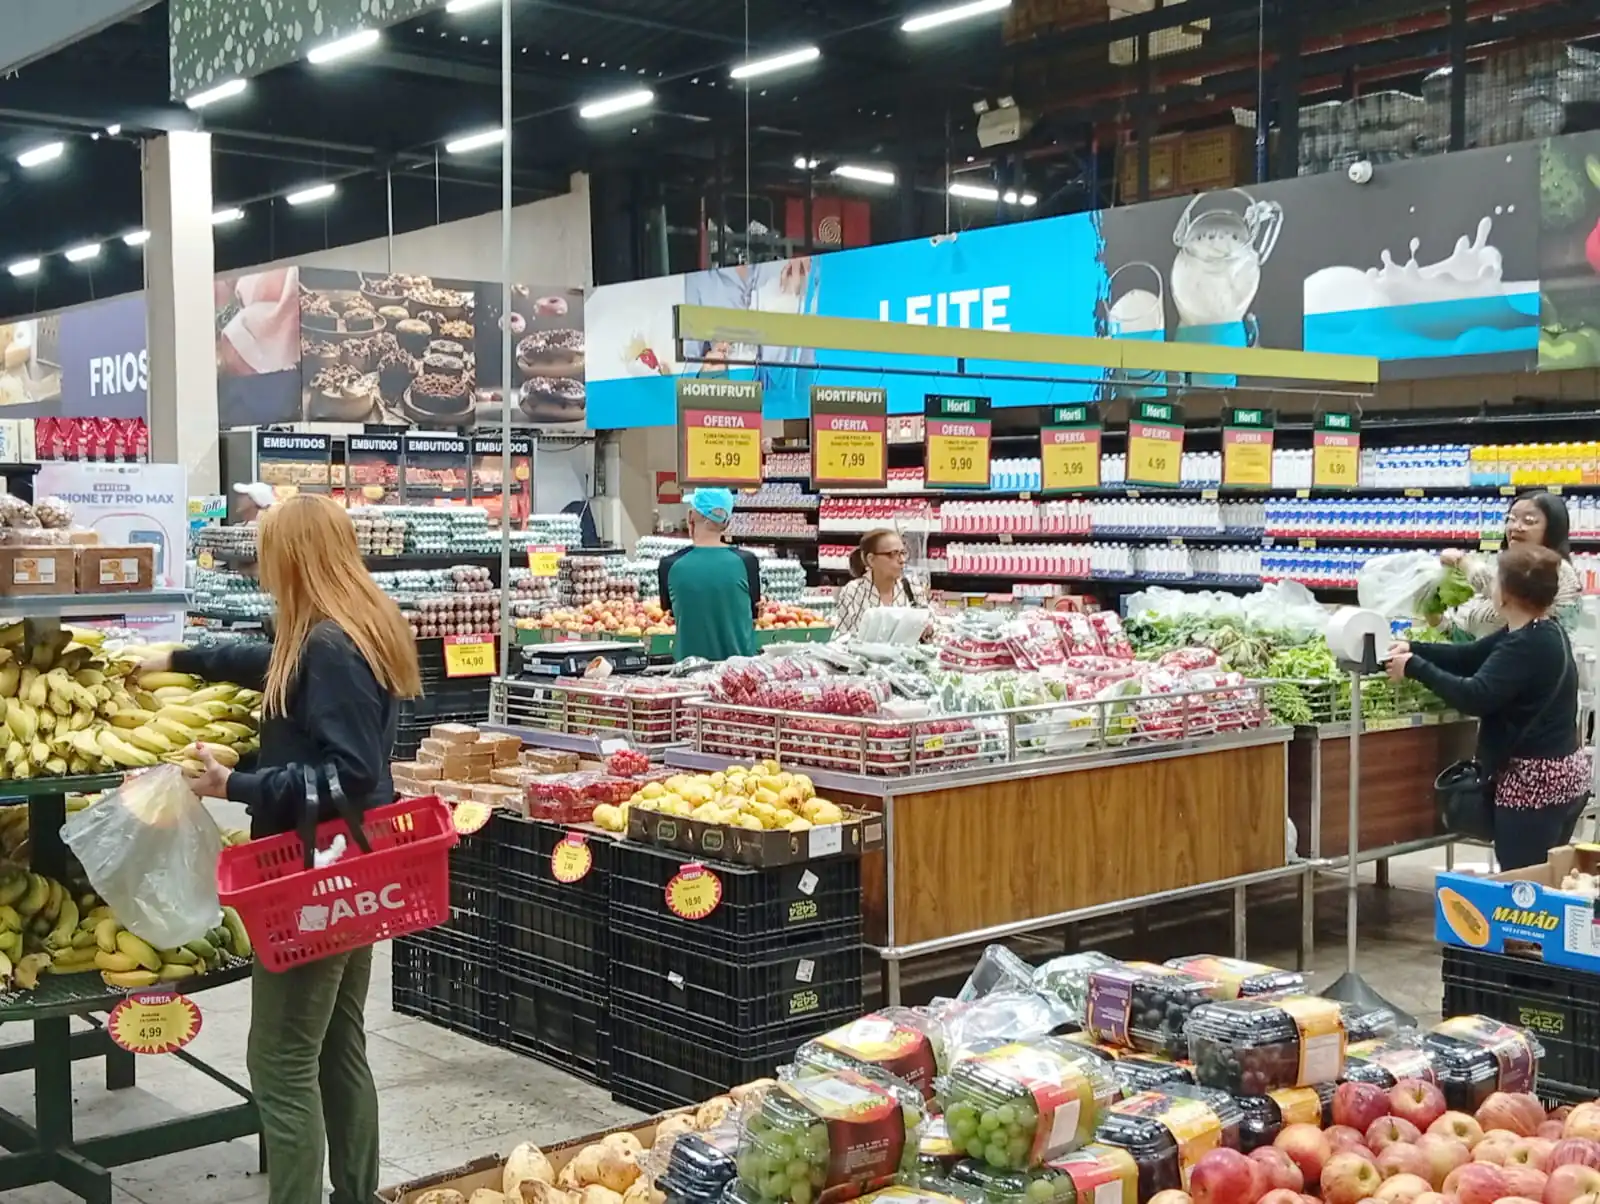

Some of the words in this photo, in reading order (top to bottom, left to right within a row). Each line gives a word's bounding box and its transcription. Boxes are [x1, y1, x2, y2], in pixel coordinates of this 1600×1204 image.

[682, 383, 756, 398] HORTIFRUTI
[816, 390, 882, 403] HORTIFRUTI
[947, 400, 970, 412] Horti
[1059, 408, 1082, 421] Horti
[703, 415, 745, 428] OFERTA
[831, 419, 869, 431] OFERTA
[941, 424, 975, 436] OFERTA
[263, 436, 326, 449] EMBUTIDOS
[1054, 431, 1086, 443] OFERTA
[351, 438, 398, 450] EMBUTIDOS
[408, 441, 464, 452] EMBUTIDOS
[714, 453, 741, 468] 5,99
[840, 453, 865, 468] 7,99
[950, 457, 972, 471] 9,90
[101, 494, 113, 503] 17
[116, 494, 143, 503] PRO
[146, 494, 174, 503] MAX
[331, 882, 405, 926] ABC
[1492, 906, 1559, 931] MAMÃO
[140, 996, 171, 1005] OFERTA
[140, 1027, 161, 1039] 4,99
